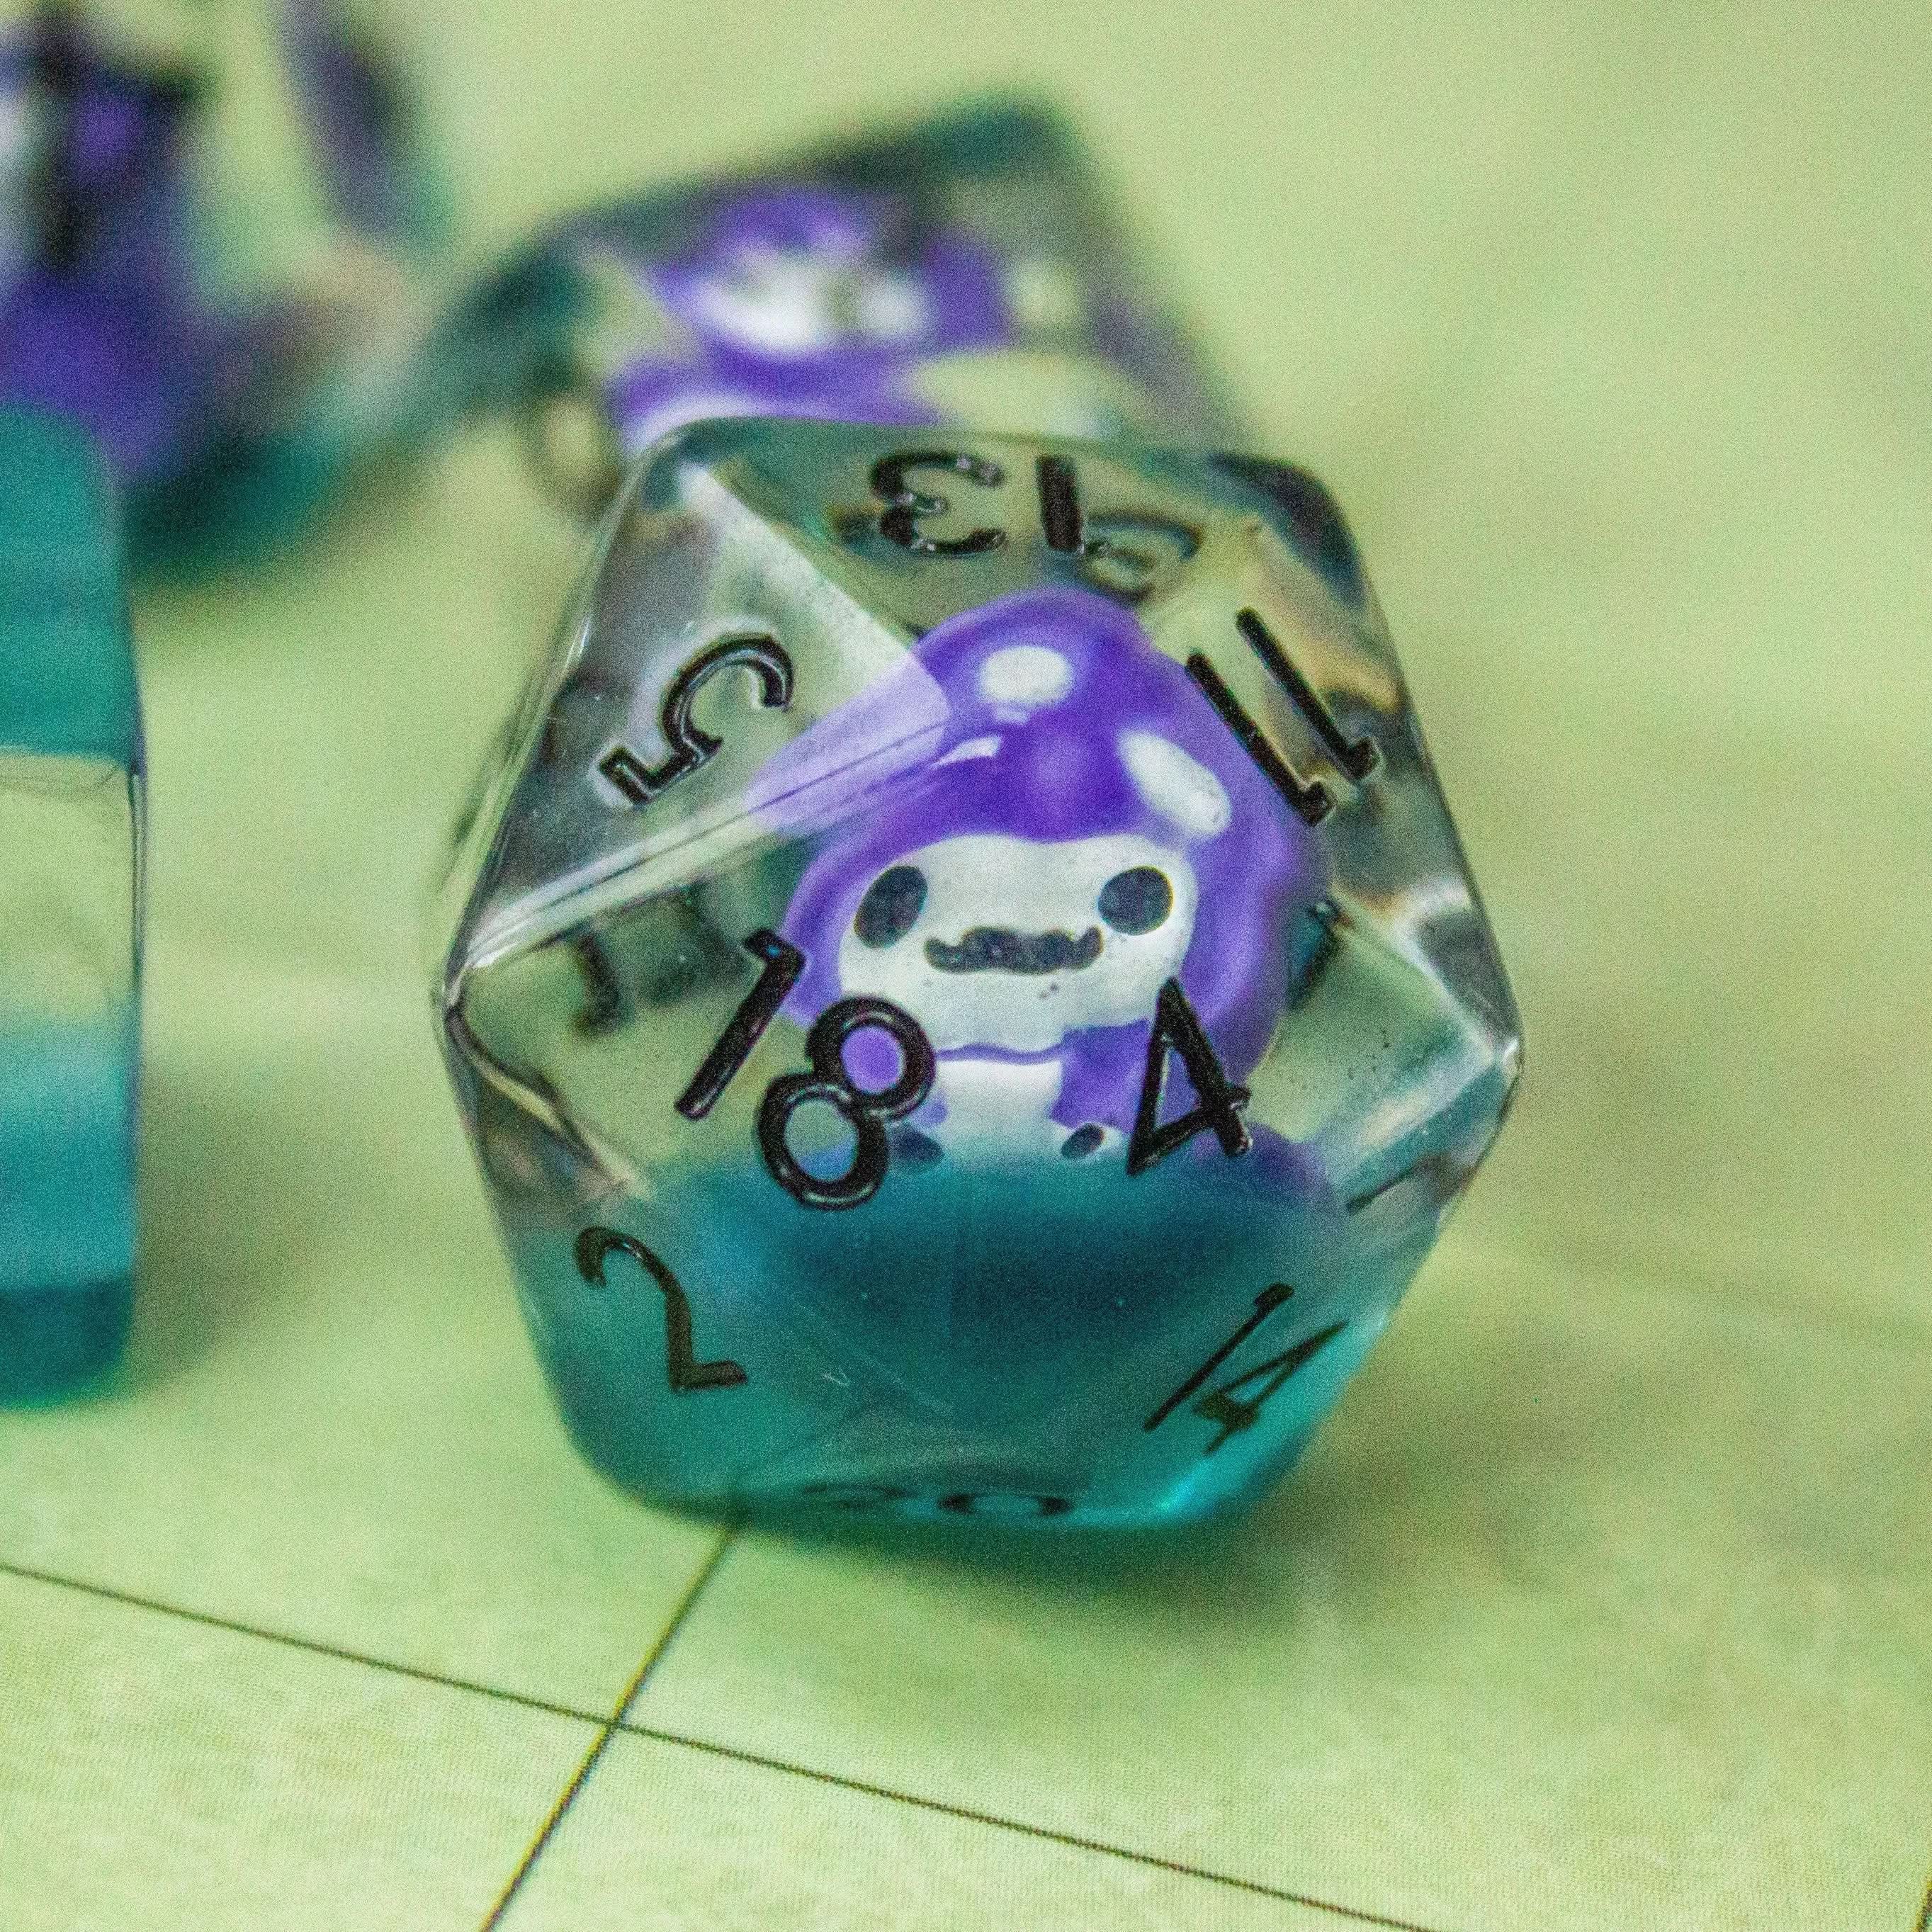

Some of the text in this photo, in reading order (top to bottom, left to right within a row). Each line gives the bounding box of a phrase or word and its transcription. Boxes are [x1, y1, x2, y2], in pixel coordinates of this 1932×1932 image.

[599, 633, 793, 806] 5
[1186, 607, 1379, 825] 11
[674, 927, 937, 1210] 18
[1126, 976, 1253, 1175] 4
[575, 1226, 748, 1394] 2
[1143, 1282, 1349, 1454] 14
